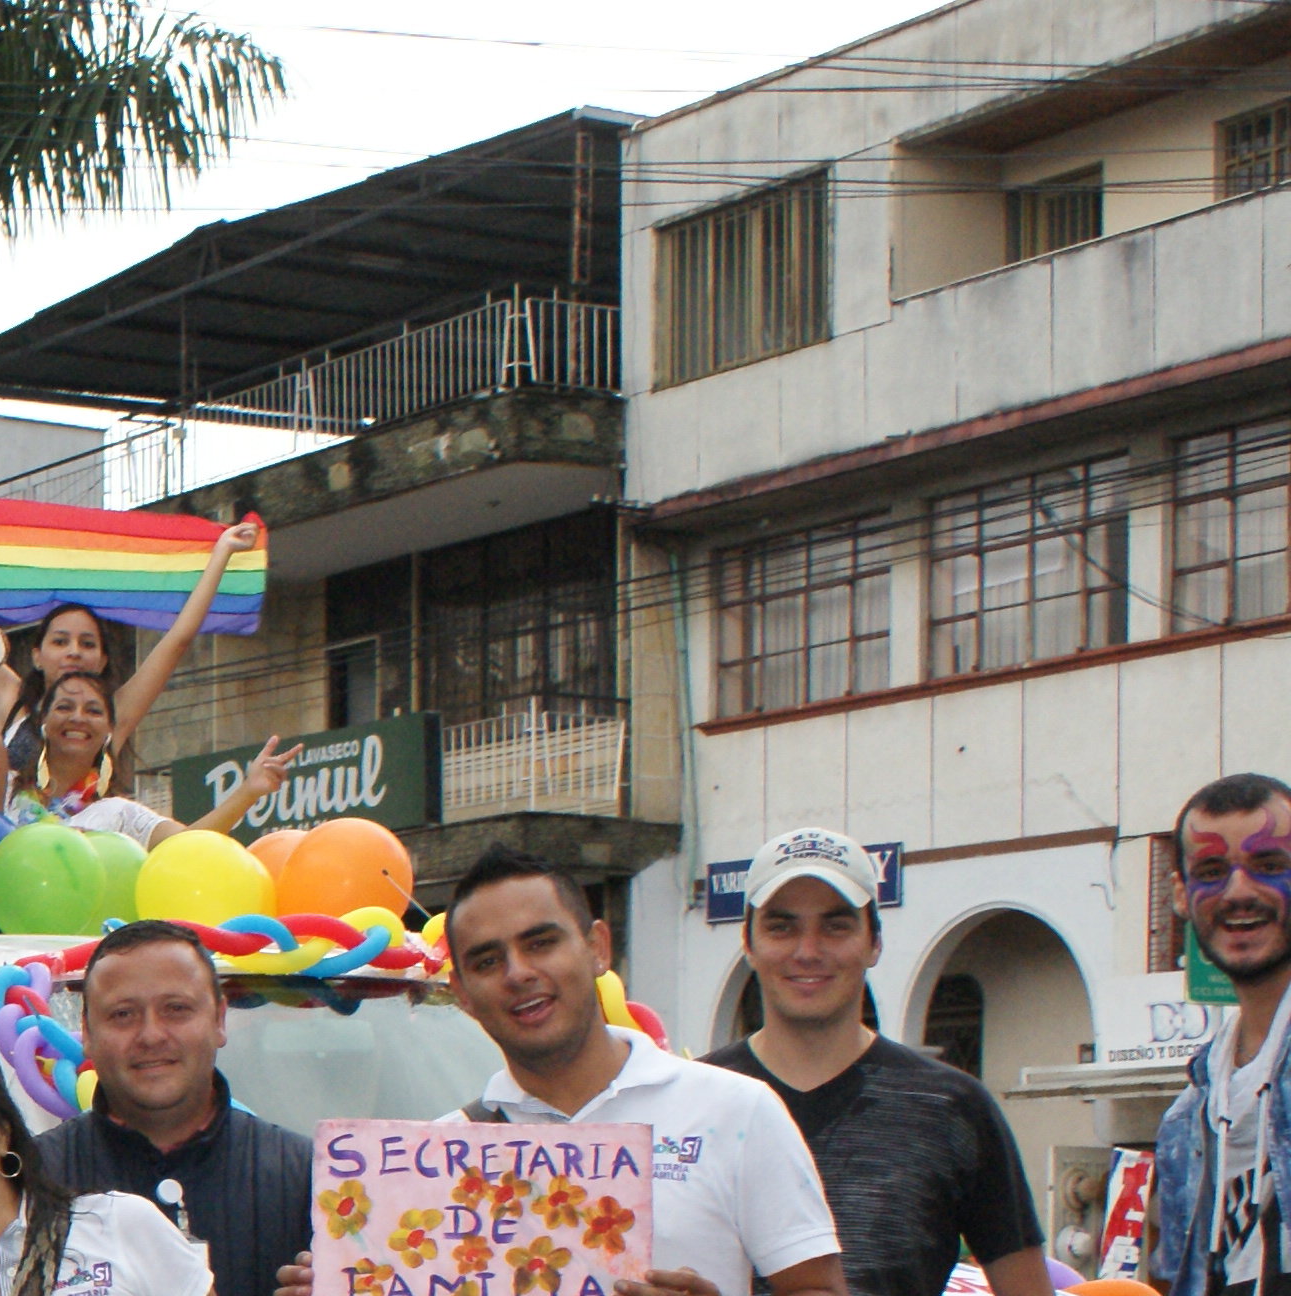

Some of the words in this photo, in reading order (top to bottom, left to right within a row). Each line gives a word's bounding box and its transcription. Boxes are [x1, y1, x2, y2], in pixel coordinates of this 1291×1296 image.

[299, 740, 360, 768] LAVASECO
[327, 1133, 640, 1181] SECRETARIA
[442, 1204, 519, 1244] DE
